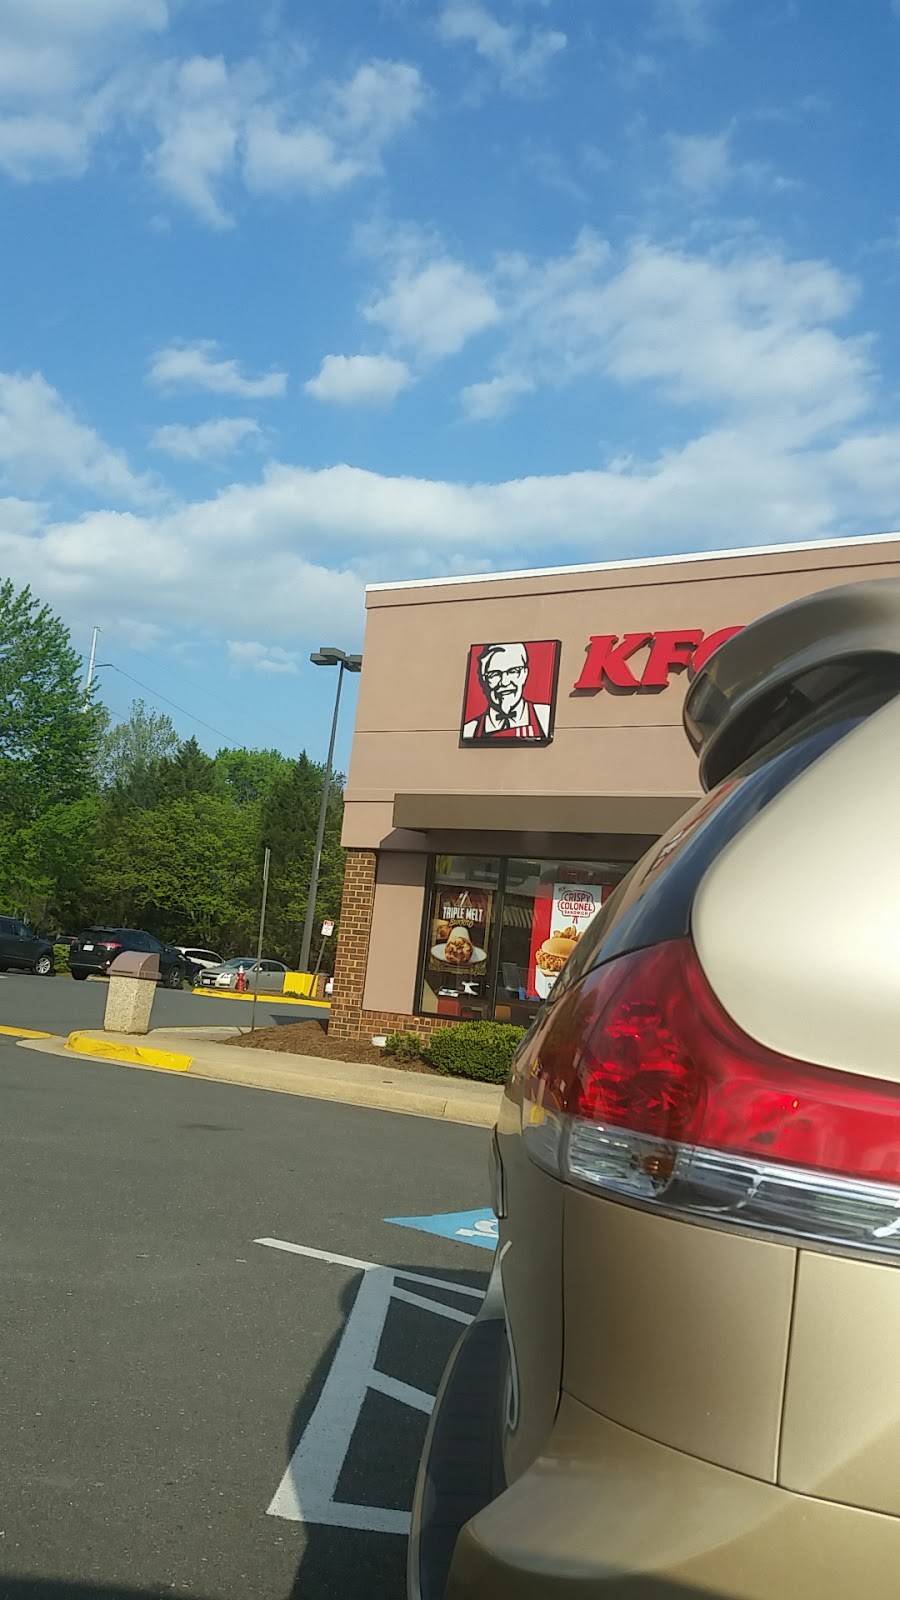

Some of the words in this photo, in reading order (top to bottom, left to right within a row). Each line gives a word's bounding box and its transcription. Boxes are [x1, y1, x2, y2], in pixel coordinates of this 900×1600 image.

[564, 892, 591, 902] CRISPY
[560, 901, 592, 911] COLONEL
[443, 907, 465, 919] TRIPLE
[466, 908, 483, 922] MELT
